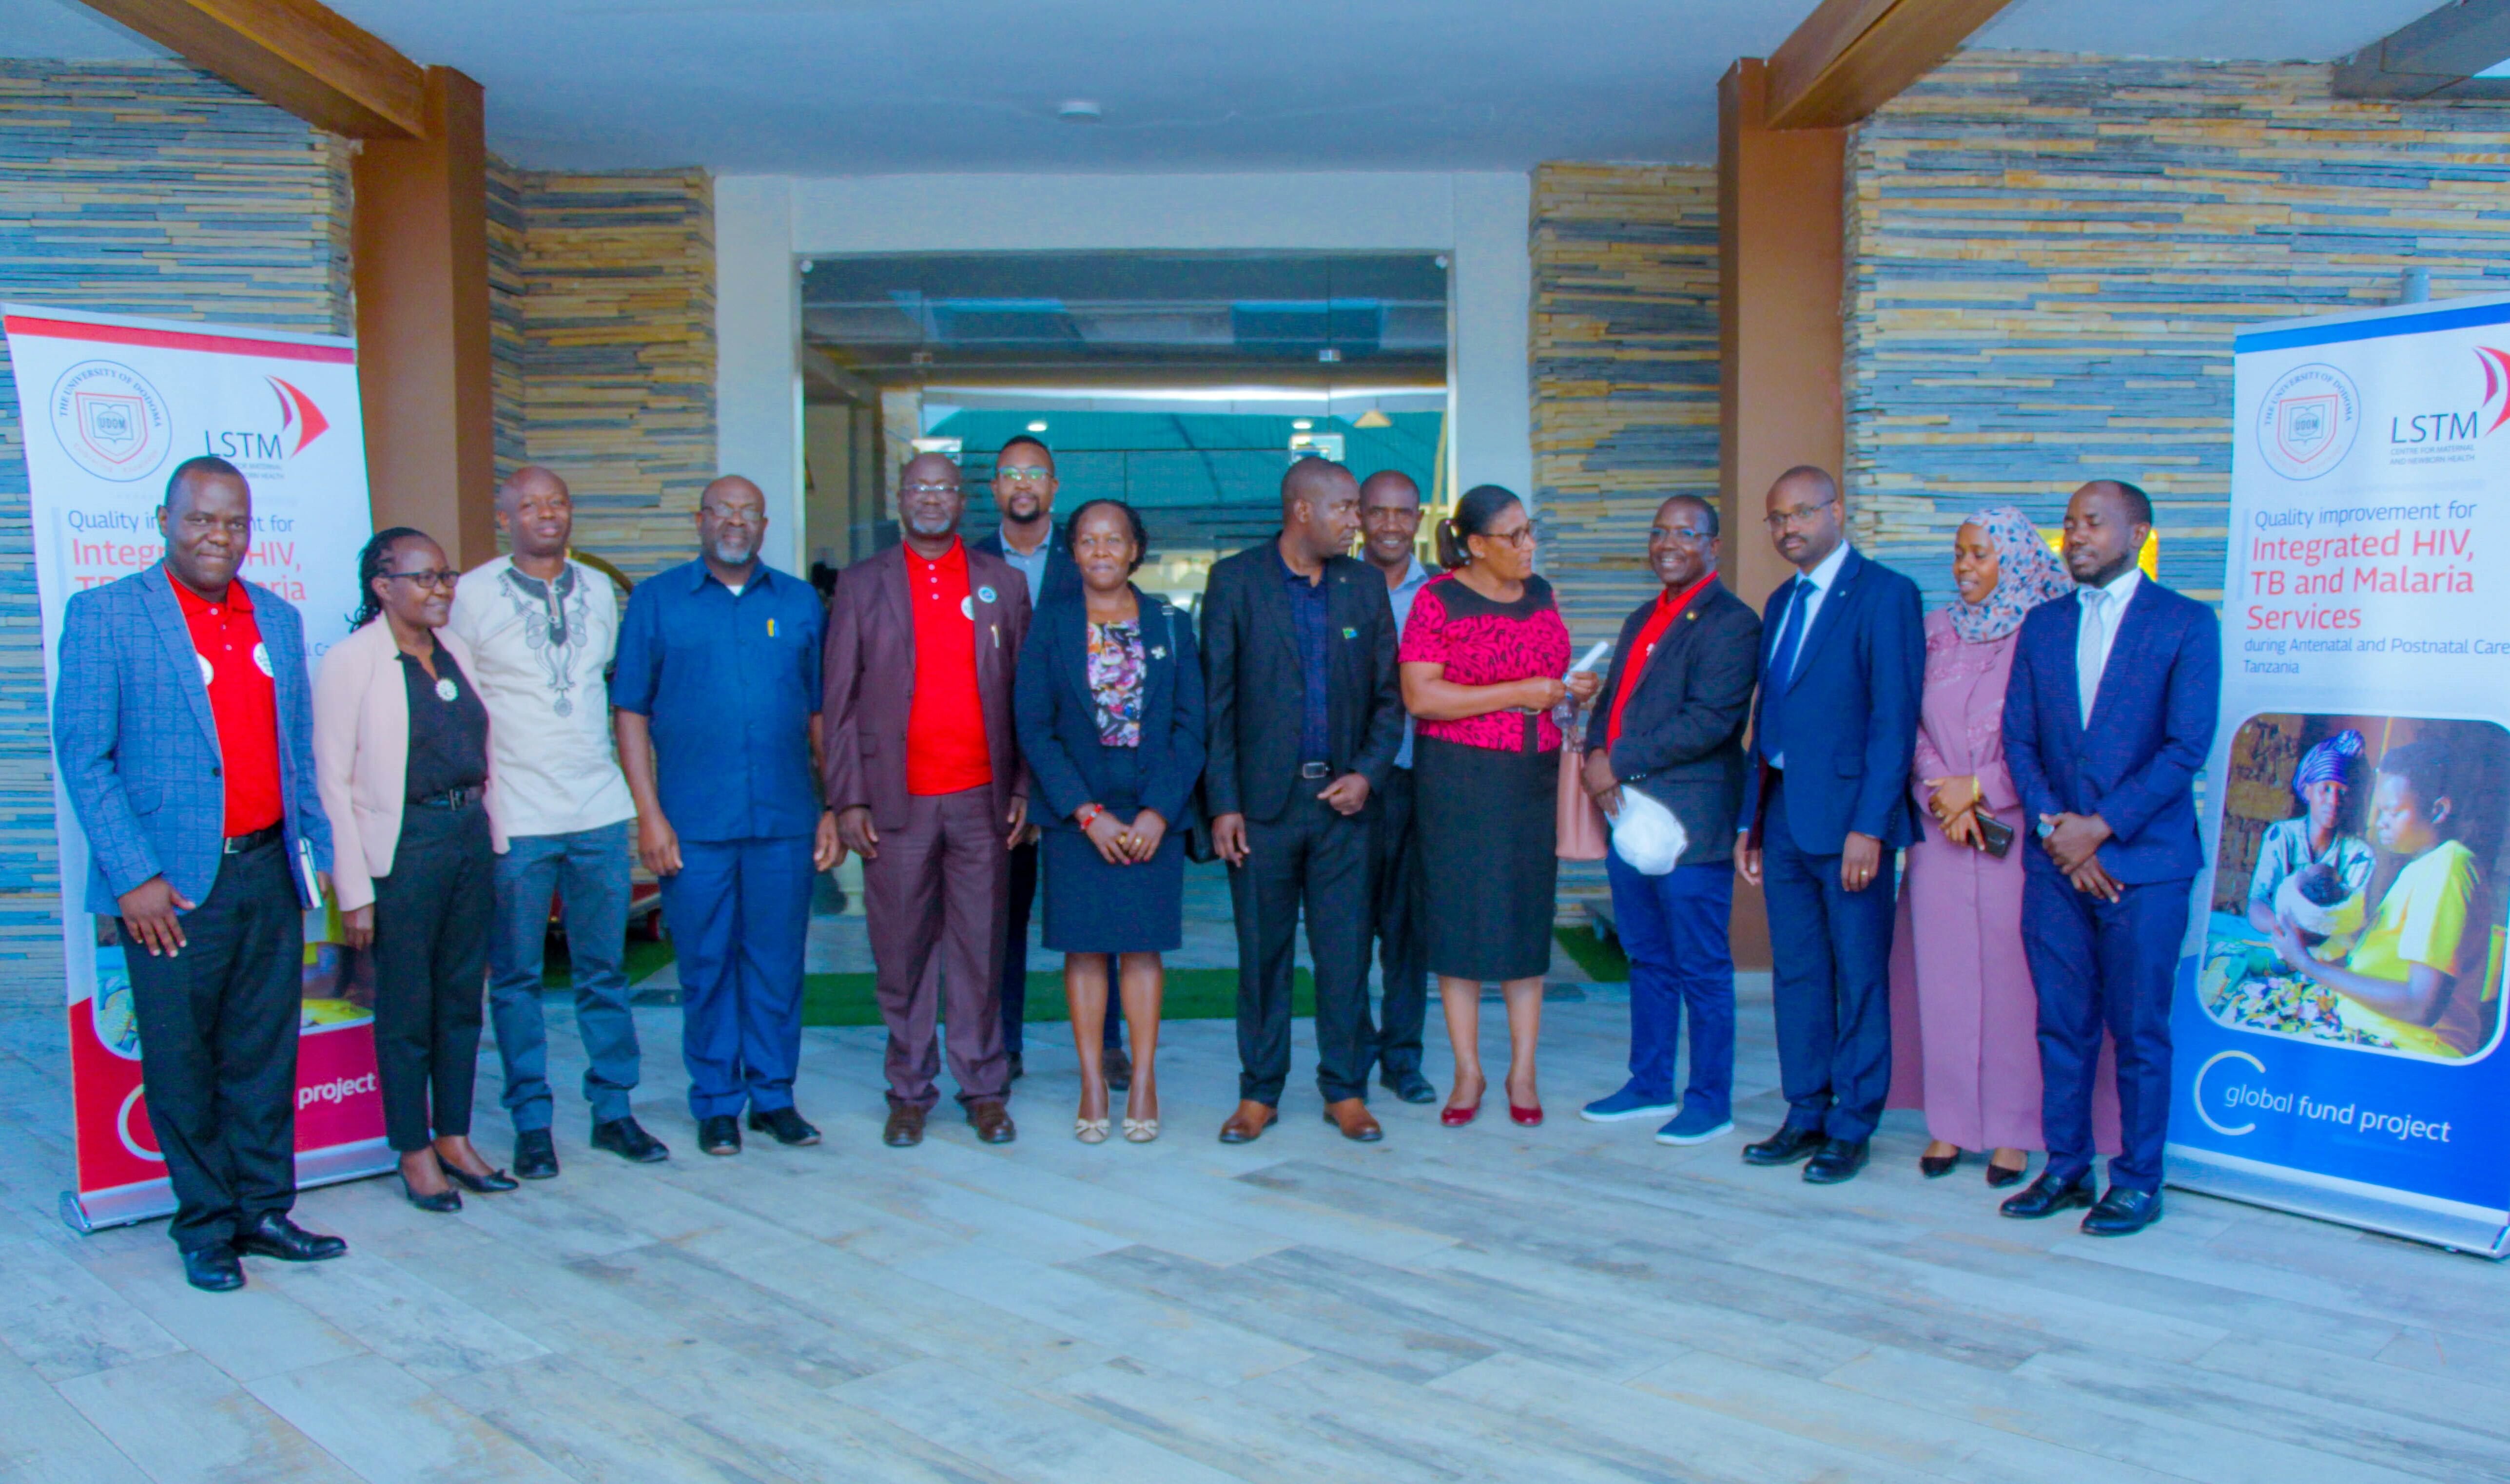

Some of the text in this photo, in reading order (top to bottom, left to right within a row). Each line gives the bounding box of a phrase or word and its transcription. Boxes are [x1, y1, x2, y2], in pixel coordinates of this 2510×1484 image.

[63, 368, 118, 396] UNIVERSITY
[118, 373, 133, 384] OF
[133, 383, 162, 427] DODOMA
[2273, 371, 2319, 405] UNIVERSITY
[2320, 373, 2334, 382] OF
[2333, 380, 2353, 422] DODOMA
[2390, 411, 2478, 444] LSTM
[205, 429, 283, 460] LSTM
[2391, 447, 2418, 456] CENTRE
[2435, 444, 2475, 453] MATERNAL
[2390, 457, 2407, 466] AND
[68, 510, 139, 534] Quality
[270, 515, 295, 532] for
[2255, 501, 2477, 529] Quality improvement for
[2252, 529, 2474, 566] Integrated HIV,
[2251, 565, 2474, 596] TB and Malaria
[2247, 603, 2361, 630] Services
[2245, 637, 2510, 655] during Antenatal and Postnatal Care
[2243, 659, 2299, 674] Tanzania
[298, 1073, 377, 1109] project
[2225, 1084, 2452, 1142] global fund project
